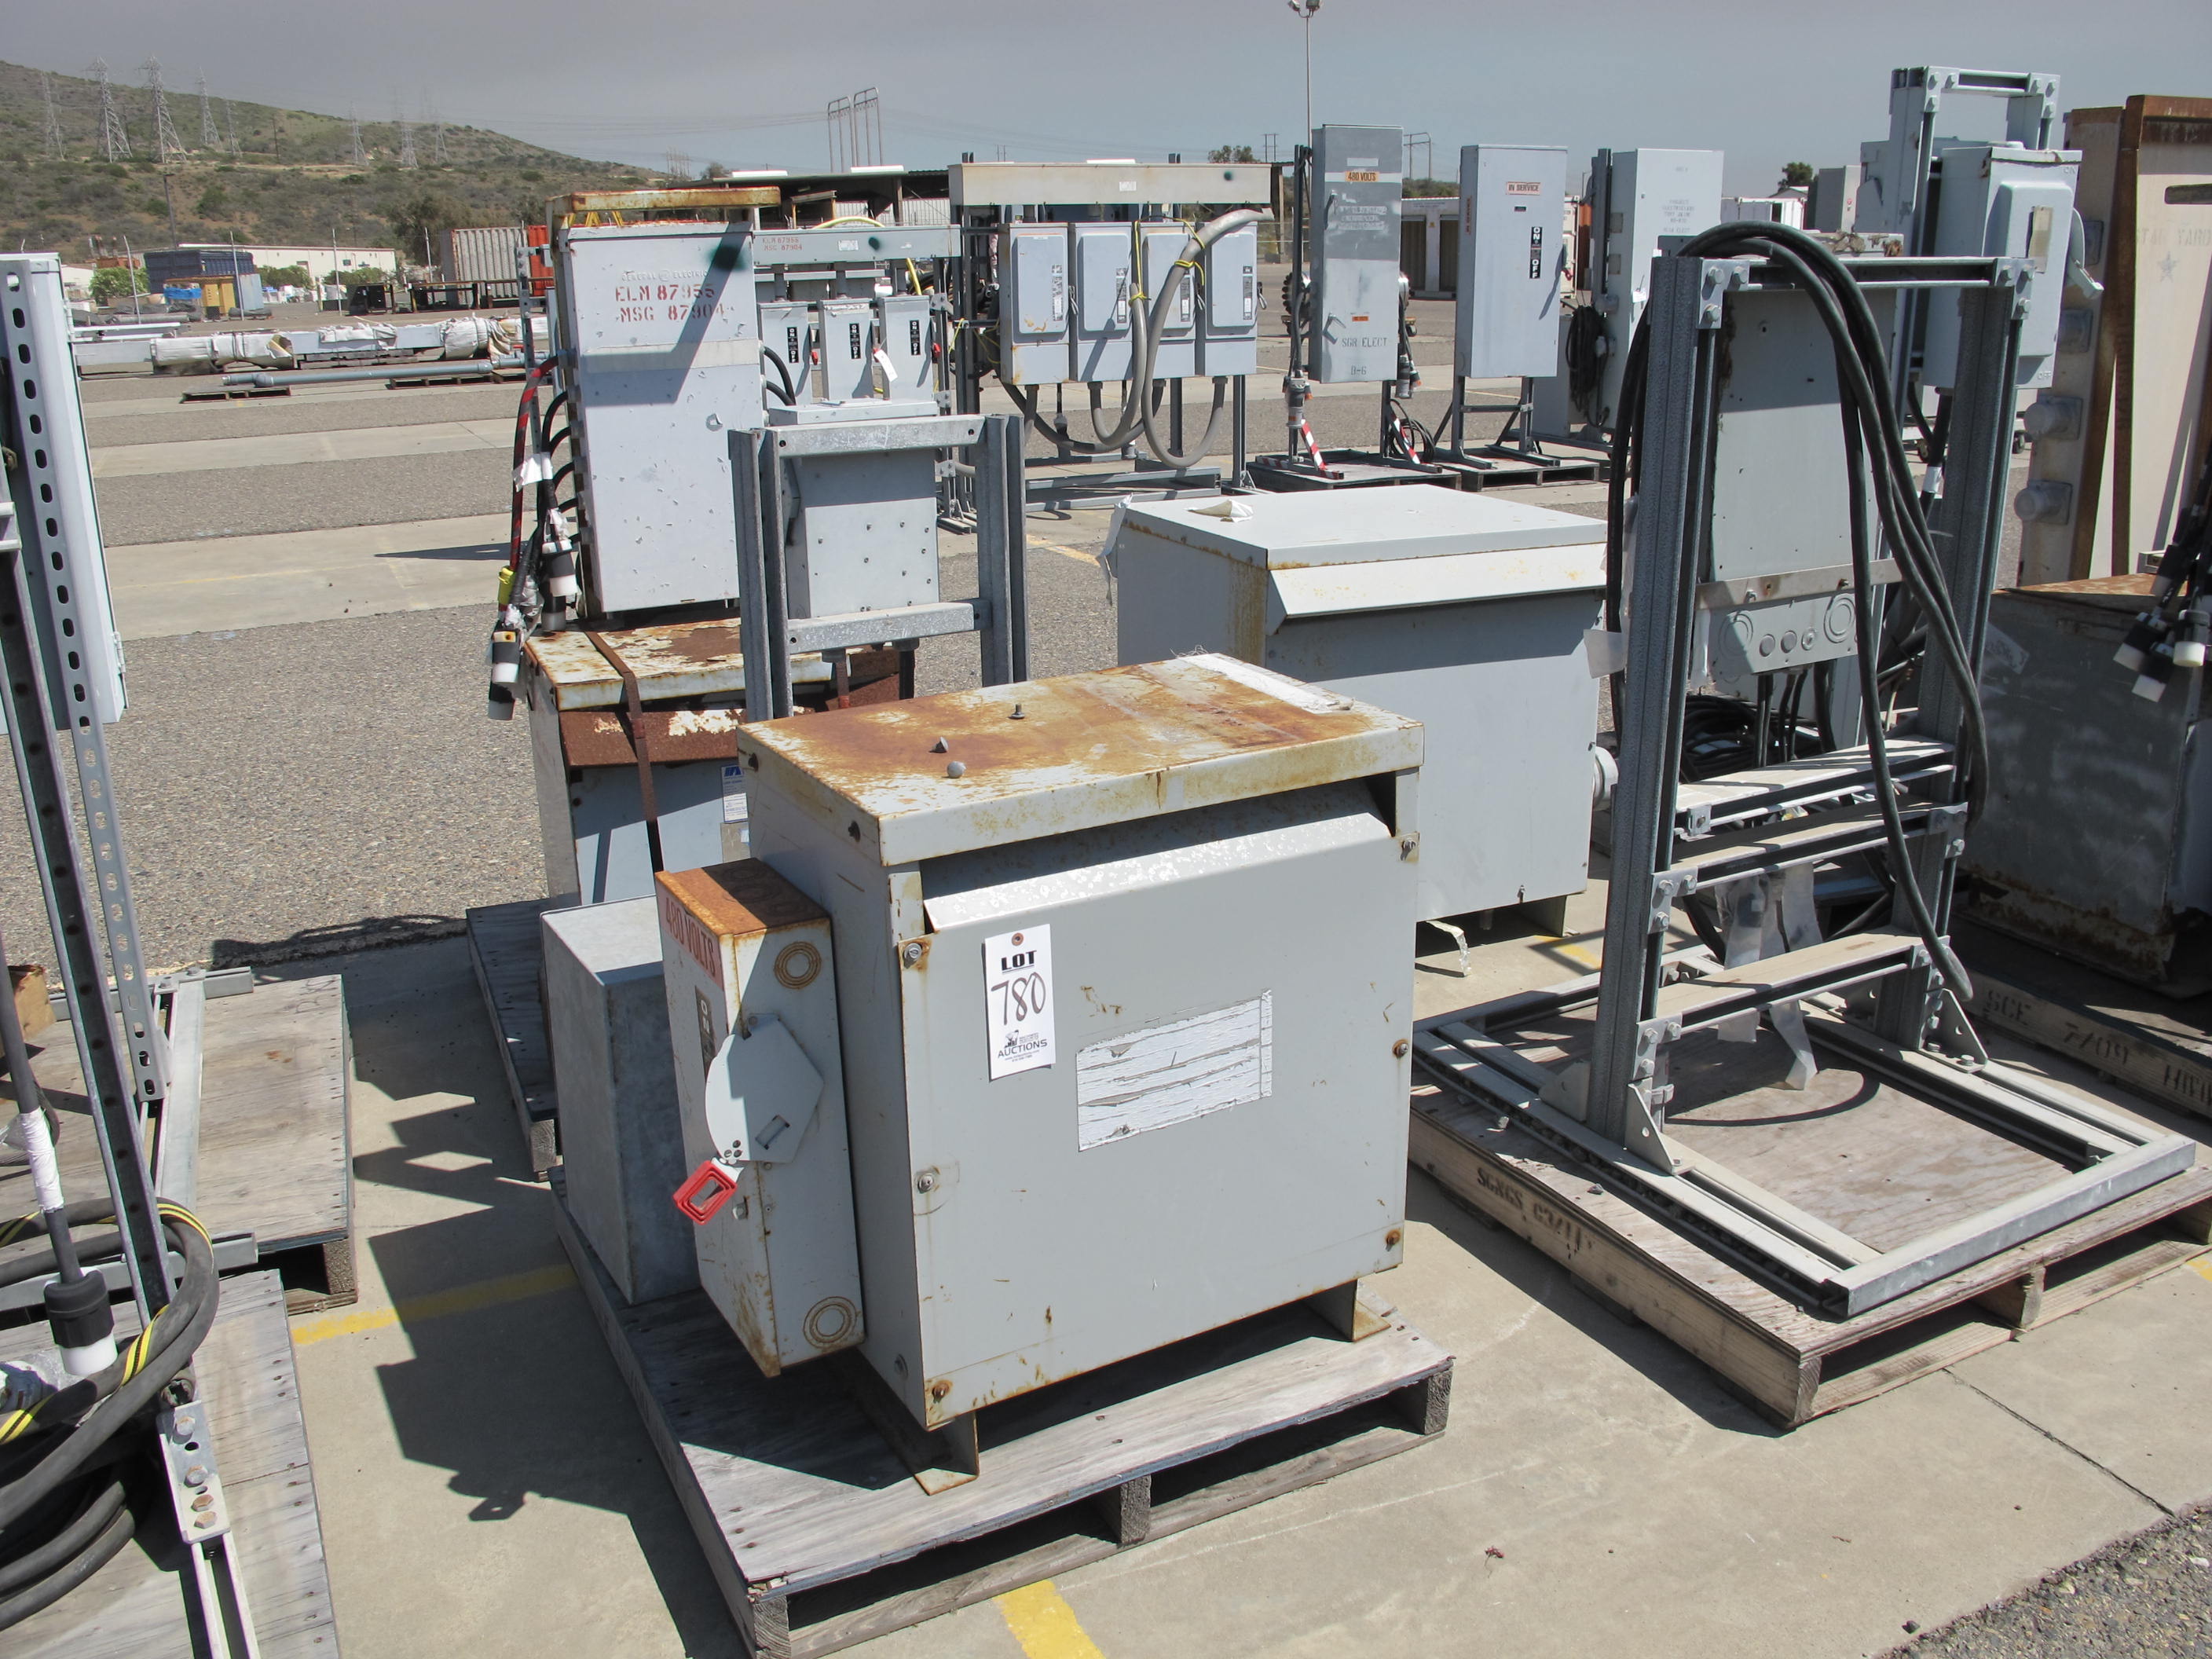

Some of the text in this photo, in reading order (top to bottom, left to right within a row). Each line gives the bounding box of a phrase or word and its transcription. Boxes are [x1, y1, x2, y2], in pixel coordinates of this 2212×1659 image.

[1347, 172, 1376, 181] 480 VOLTS
[1533, 227, 1540, 240] ON
[616, 284, 650, 302] ELM
[620, 303, 724, 323] MSG 87904
[1361, 337, 1388, 347] ELECT
[665, 896, 716, 977] 480 VOLTS
[1001, 950, 1038, 971] LOT
[991, 971, 1046, 1026] 780
[998, 1038, 1048, 1059] AUCTIONS
